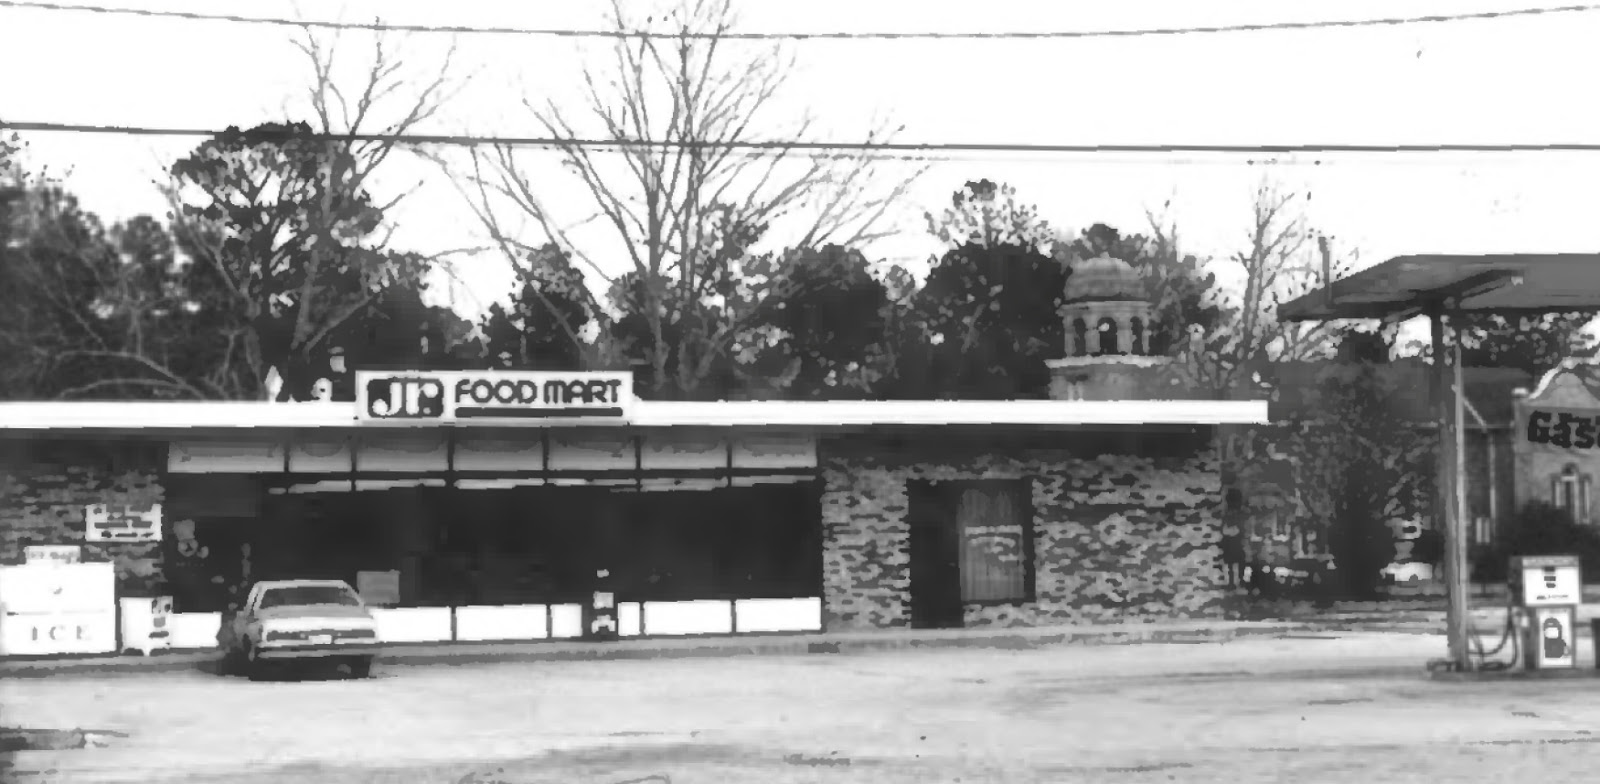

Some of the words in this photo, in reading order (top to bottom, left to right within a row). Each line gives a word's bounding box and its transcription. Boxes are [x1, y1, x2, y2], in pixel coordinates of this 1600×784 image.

[455, 378, 538, 404] FOOD
[543, 378, 622, 405] MART
[1527, 409, 1600, 449] Gas
[31, 624, 92, 641] ICE
